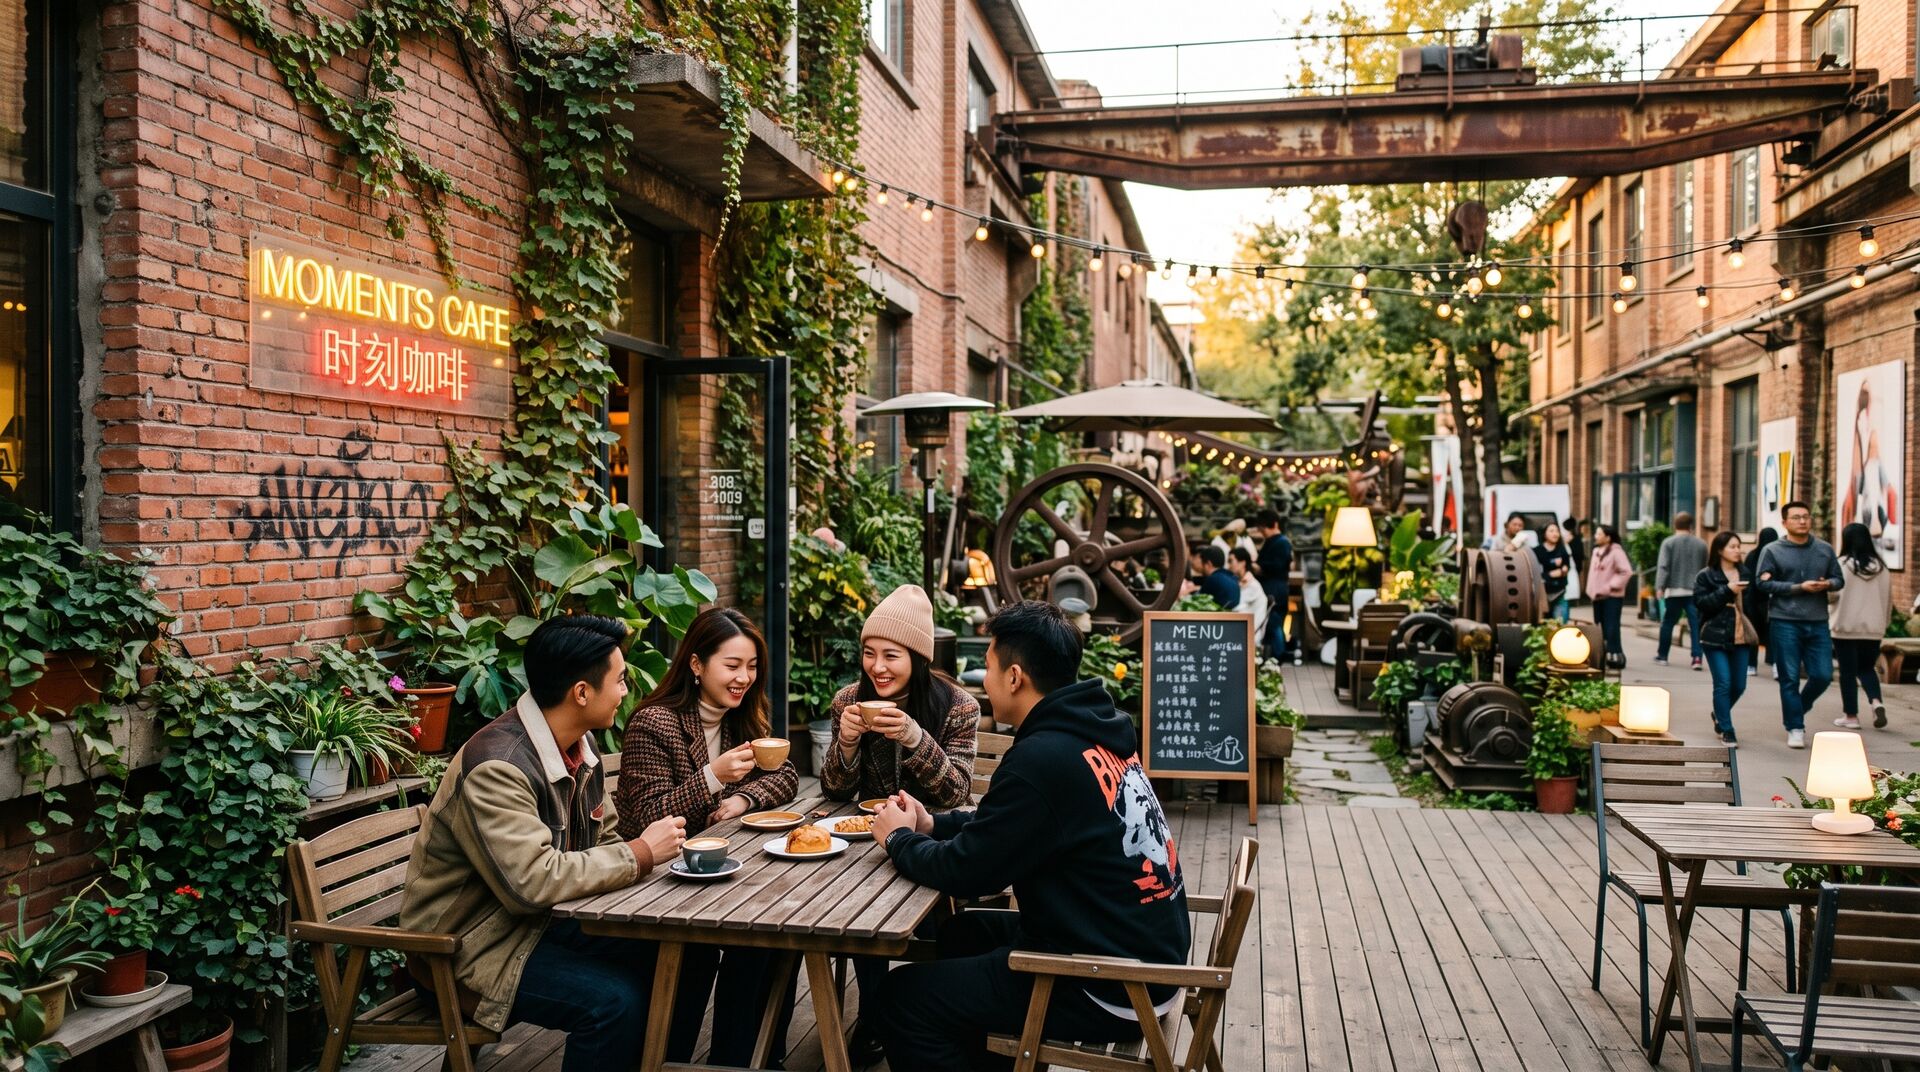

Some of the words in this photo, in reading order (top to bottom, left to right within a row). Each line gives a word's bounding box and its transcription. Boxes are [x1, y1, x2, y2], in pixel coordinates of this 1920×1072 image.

[262, 249, 434, 329] MOMENTS
[443, 296, 511, 347] CAFE
[323, 328, 469, 401] 时刻咖啡
[1172, 624, 1224, 640] MENU
